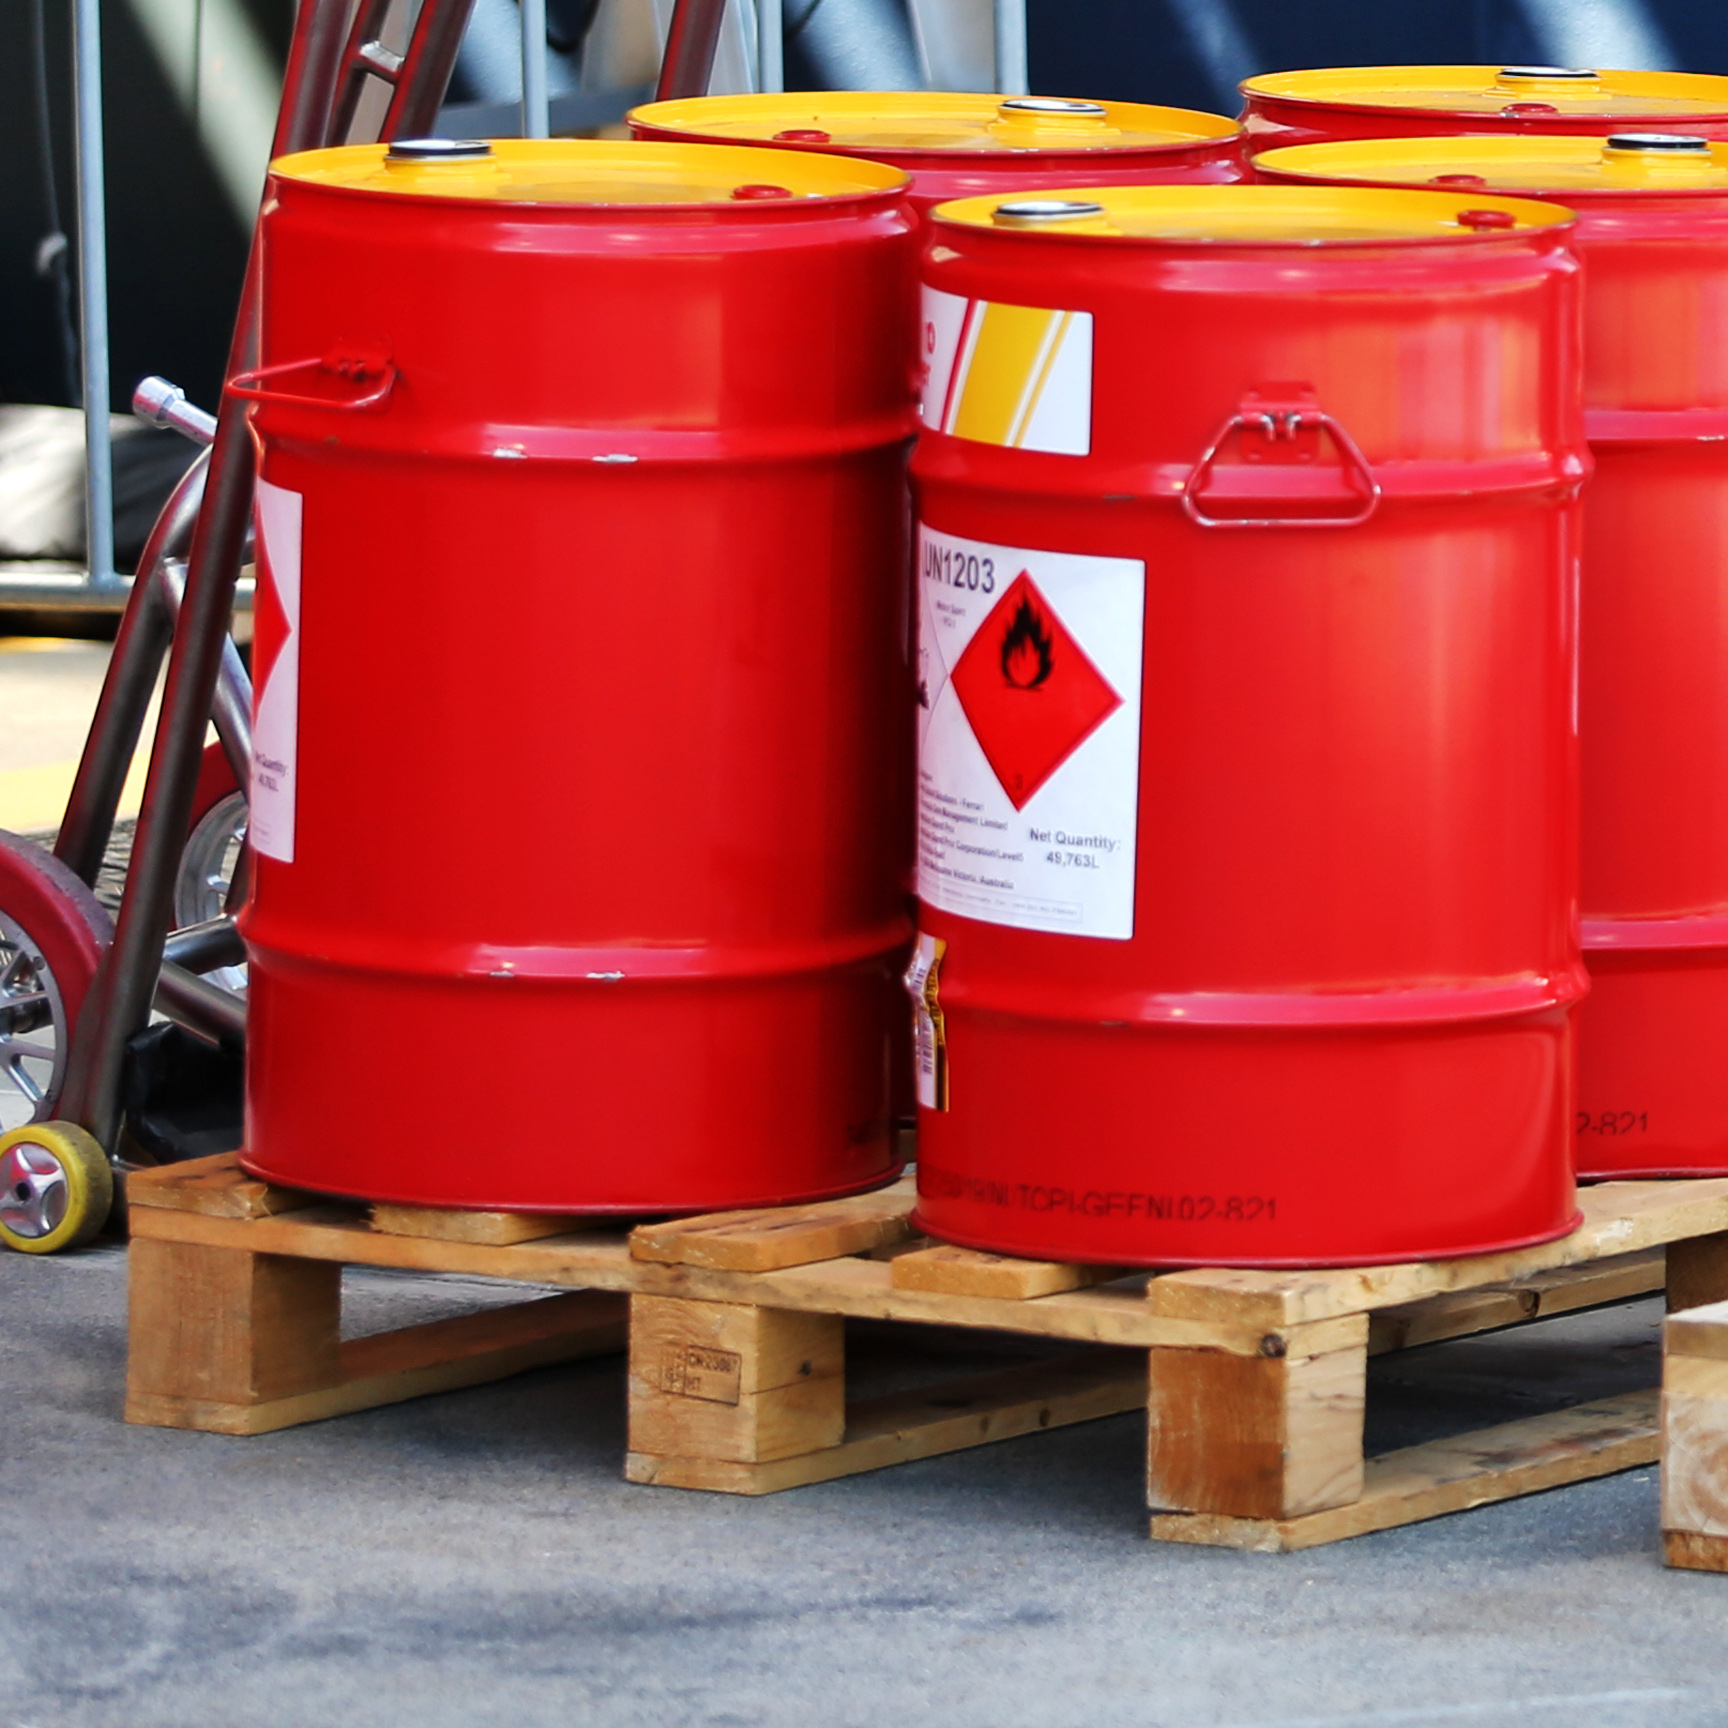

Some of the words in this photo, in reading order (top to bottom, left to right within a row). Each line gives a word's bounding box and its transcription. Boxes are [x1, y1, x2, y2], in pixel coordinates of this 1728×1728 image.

[925, 542, 996, 594] UN1203
[1030, 828, 1051, 843] Net
[1056, 830, 1121, 853] Quantity:
[1046, 851, 1100, 869] 49,763L
